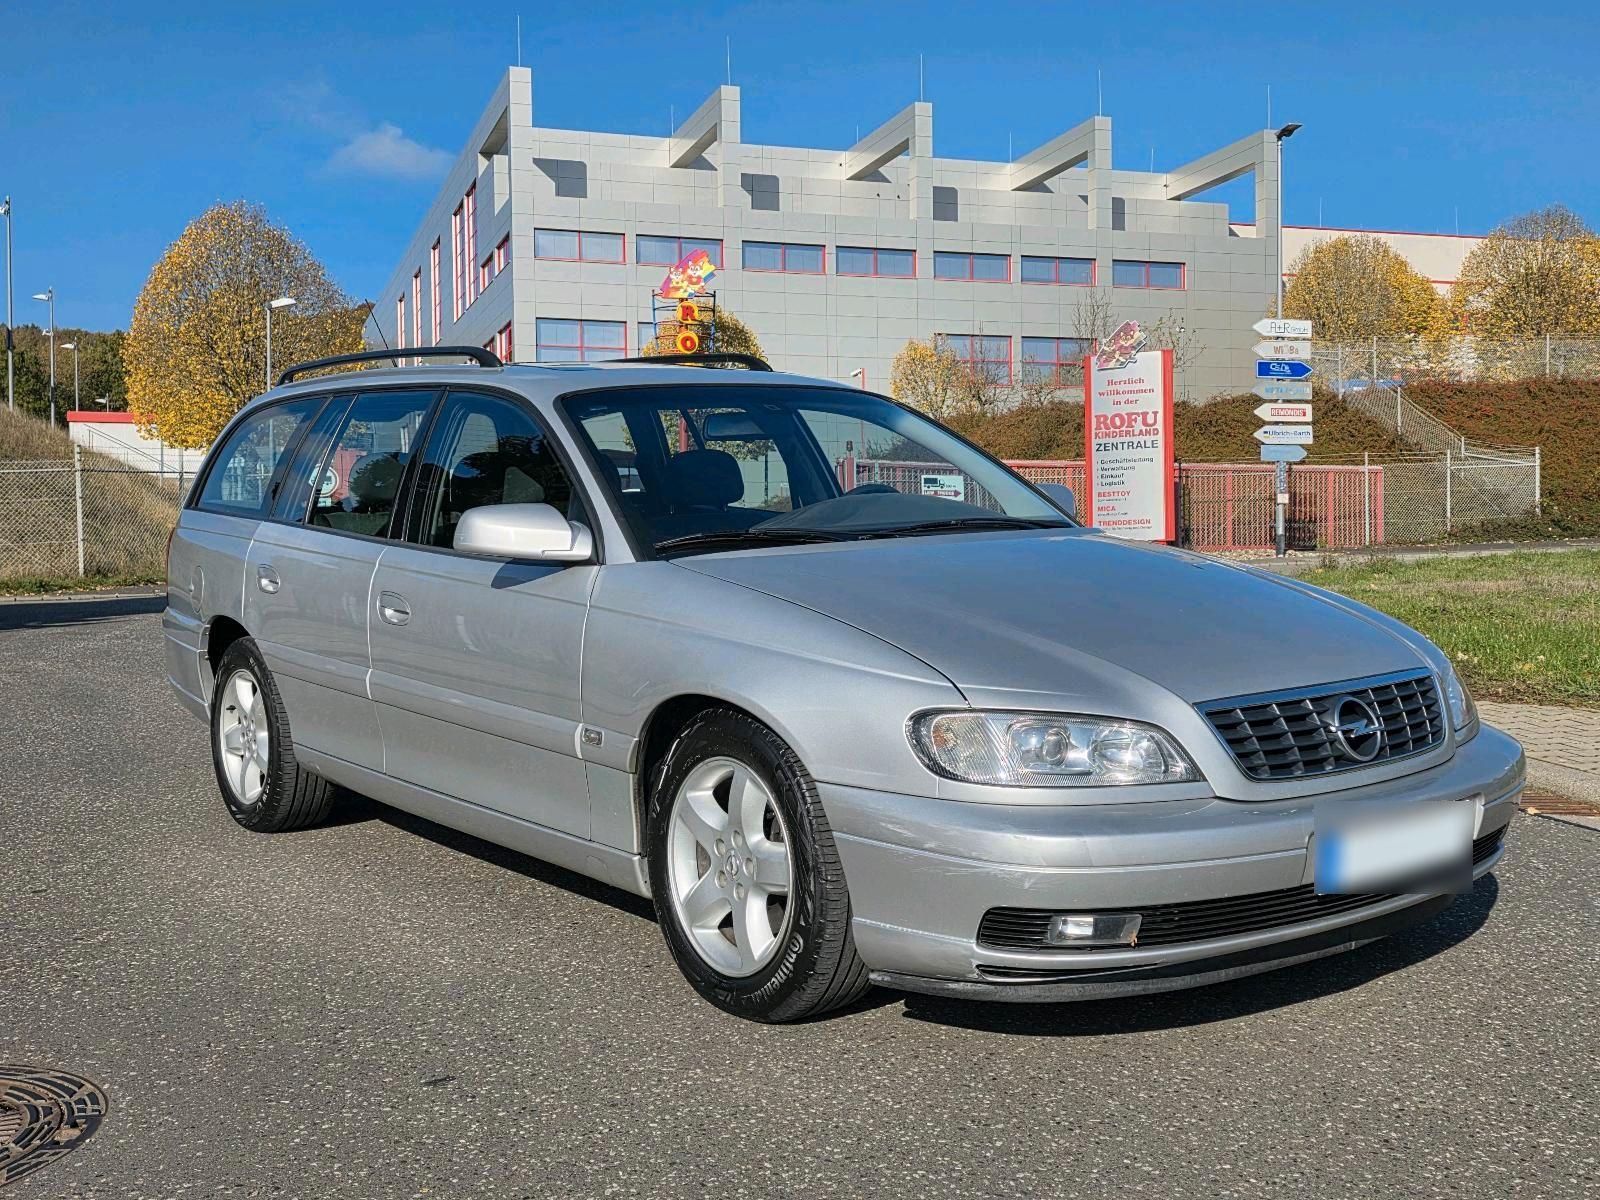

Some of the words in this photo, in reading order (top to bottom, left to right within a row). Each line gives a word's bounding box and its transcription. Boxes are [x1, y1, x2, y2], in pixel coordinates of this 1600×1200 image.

[1106, 377, 1145, 387] Herzlich
[1098, 388, 1155, 397] willkommen
[1112, 398, 1121, 406] in
[1271, 408, 1304, 416] REMONDIS
[1094, 411, 1159, 431] ROFU
[1094, 427, 1160, 440] KINDERLAND
[1095, 439, 1159, 452] ZENTRALE
[1100, 480, 1125, 488] Logistik
[1097, 490, 1131, 498] BESTTOY
[1098, 518, 1152, 527] TRENDDESIGN
